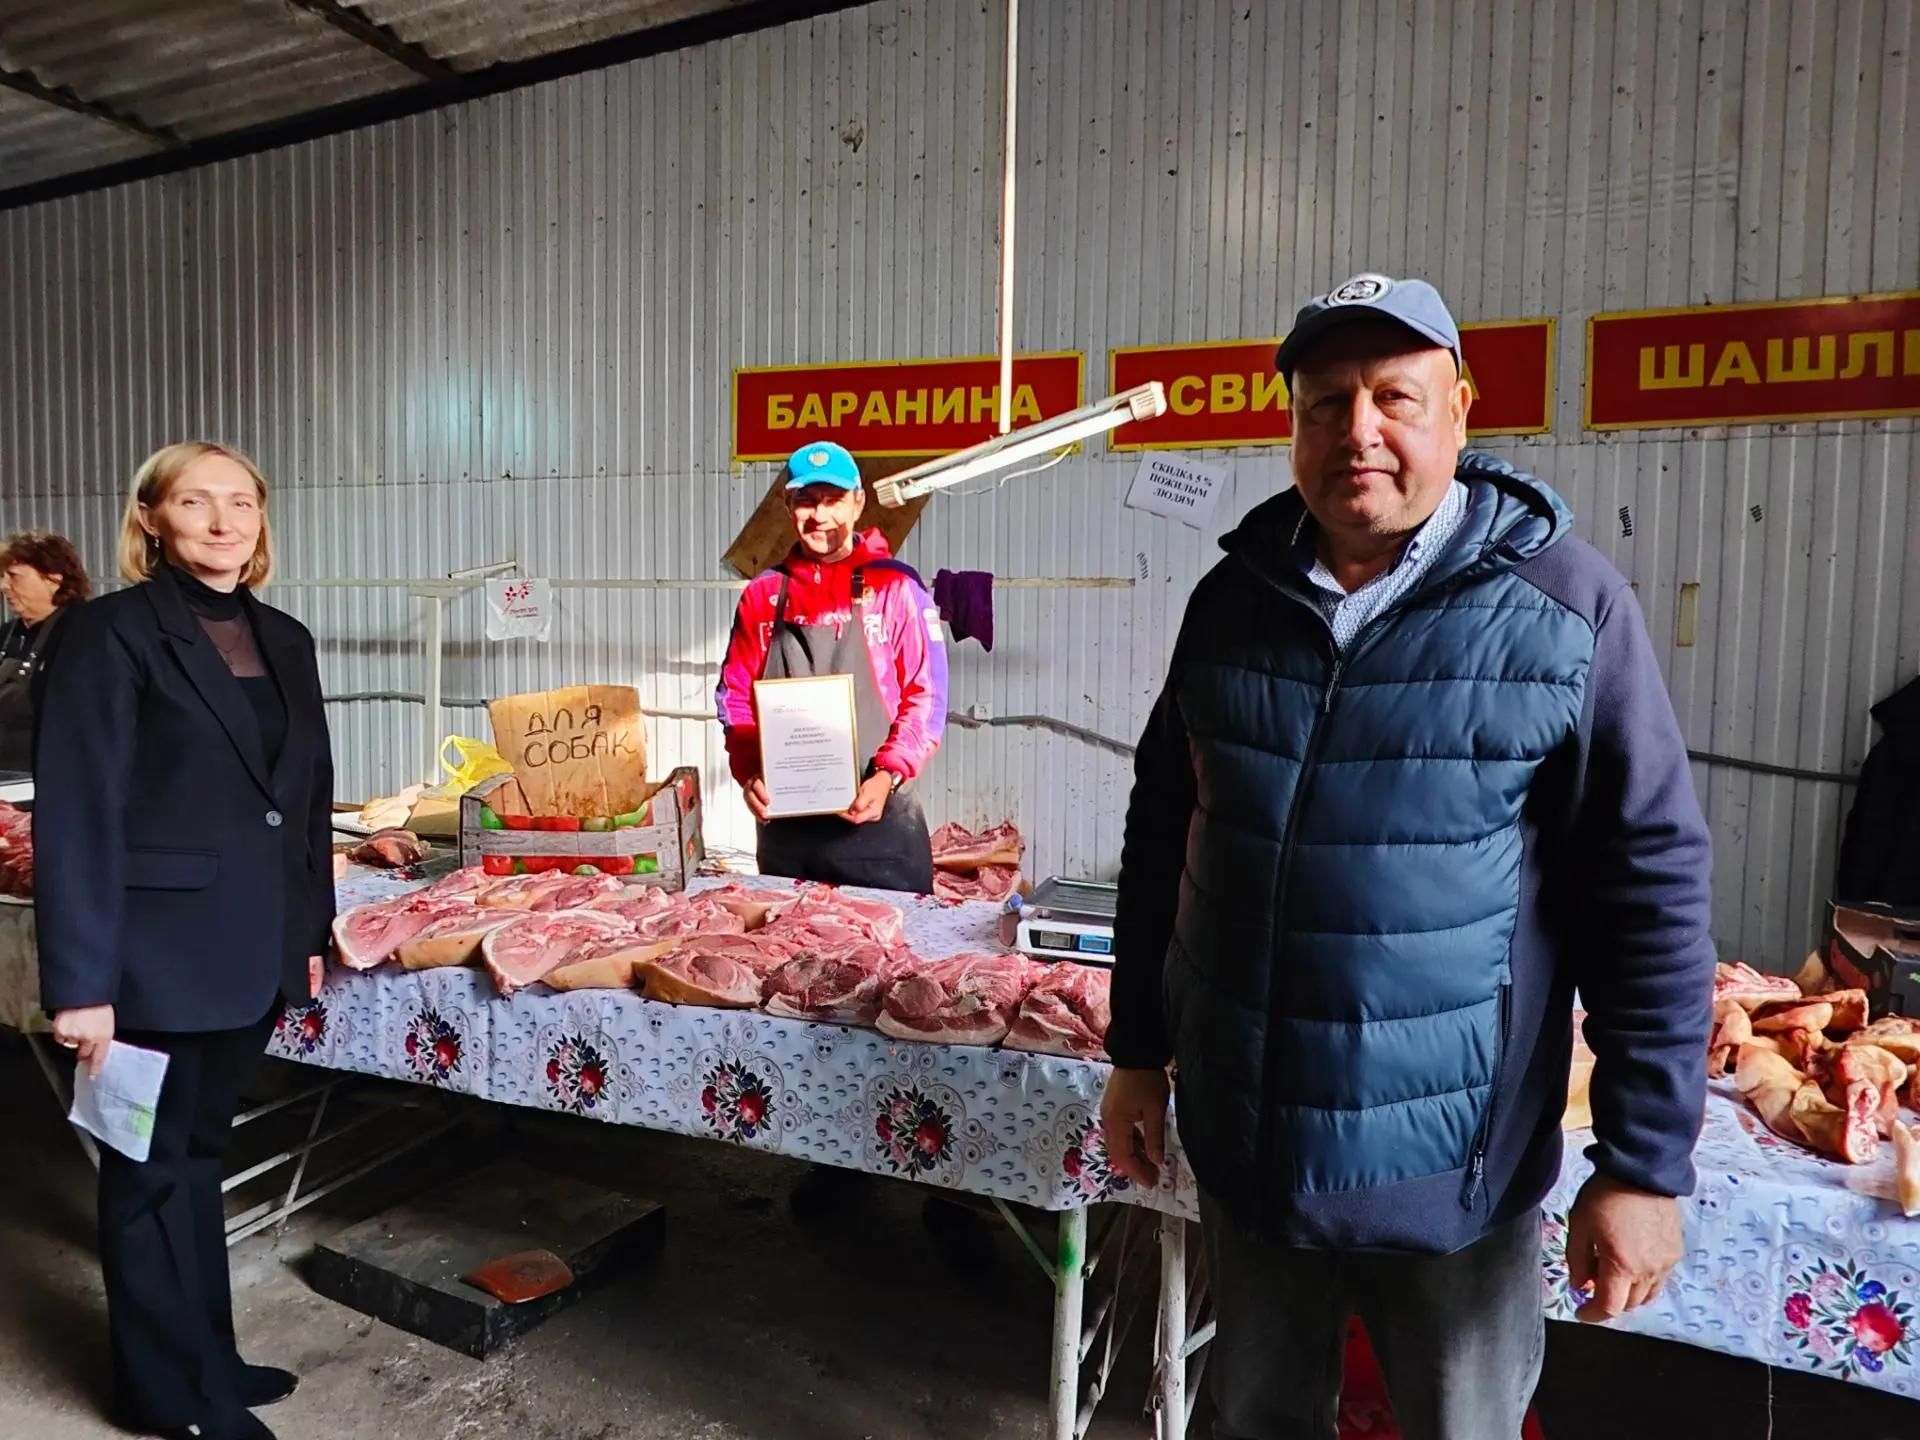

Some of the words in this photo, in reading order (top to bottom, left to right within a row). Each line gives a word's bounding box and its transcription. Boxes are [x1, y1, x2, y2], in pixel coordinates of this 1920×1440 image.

[767, 383, 1043, 430] БАРАНИНА
[1149, 473, 1208, 498] ПОЖИЛЫМ
[1151, 461, 1193, 481] СКИДКА
[1153, 487, 1195, 507] ЛЮДЯМ
[524, 704, 602, 737] ДЛЯ
[523, 731, 638, 768] СОБАК
